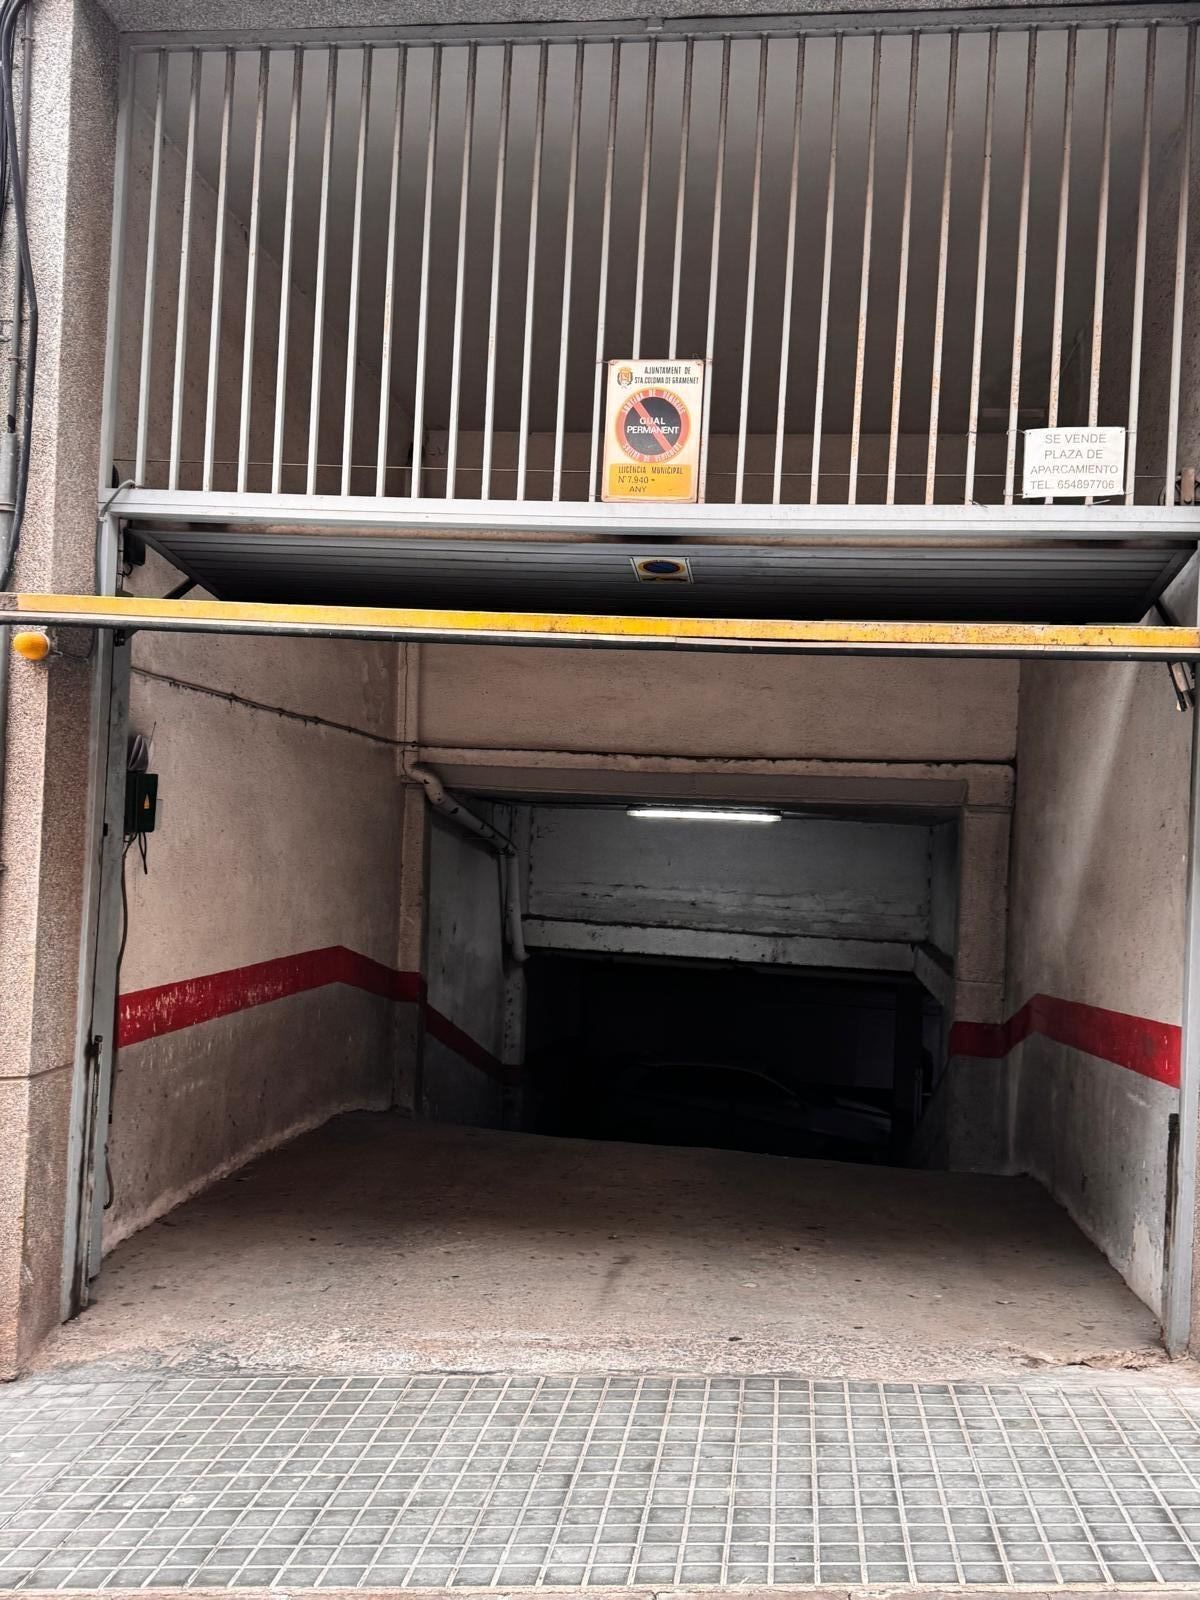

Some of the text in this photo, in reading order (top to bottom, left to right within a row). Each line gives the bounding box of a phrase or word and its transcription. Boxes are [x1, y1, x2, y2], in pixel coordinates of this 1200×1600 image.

[644, 367, 691, 375] AJUNTAMENT DE
[627, 426, 679, 434] PERMANENT
[1045, 434, 1106, 444] SE VENDE
[1044, 450, 1103, 460] PLAZA DE
[1030, 465, 1118, 474] APARCAMIENTO
[1057, 480, 1115, 489] 654897706
